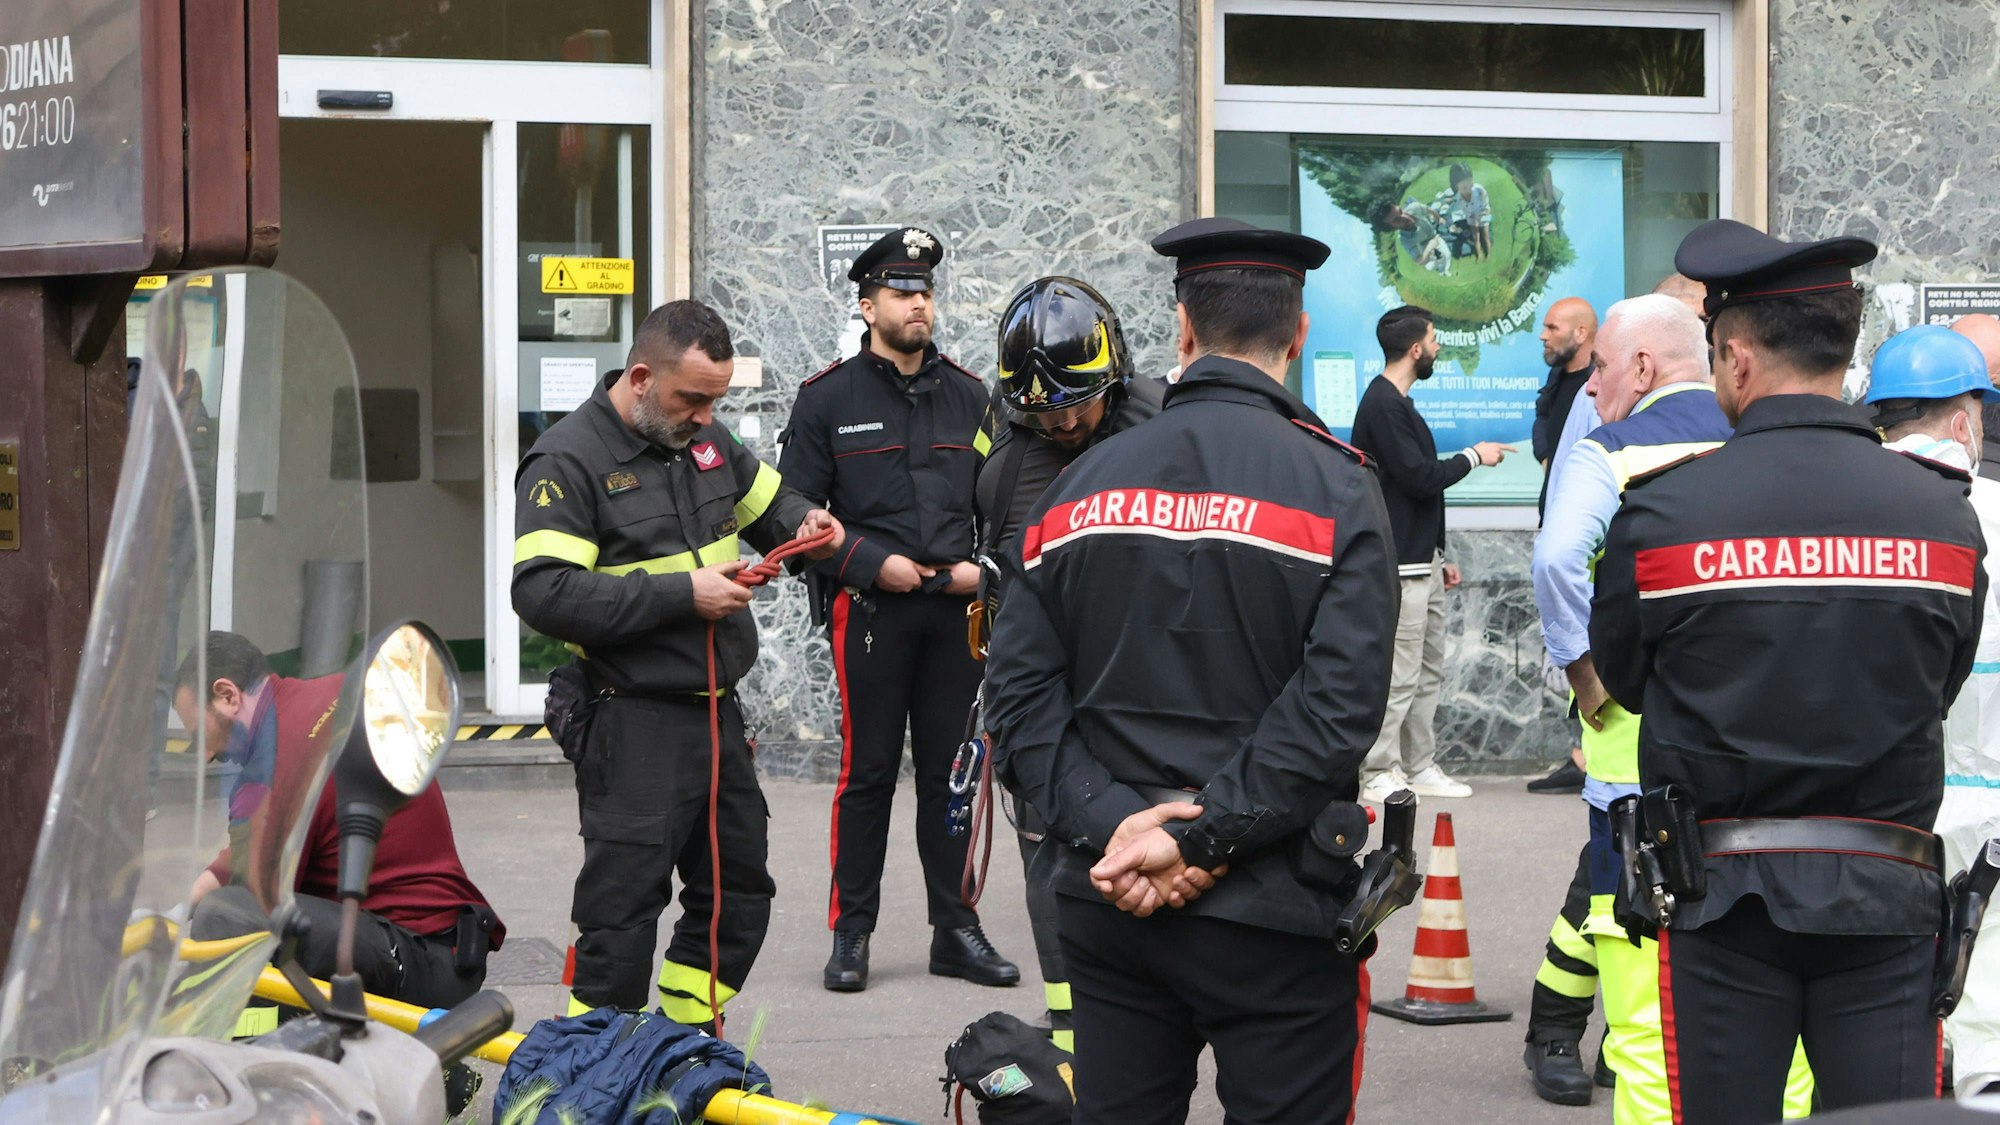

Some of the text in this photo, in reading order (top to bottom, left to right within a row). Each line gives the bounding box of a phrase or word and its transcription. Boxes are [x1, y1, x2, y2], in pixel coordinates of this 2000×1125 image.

[827, 233, 852, 242] RETE
[853, 233, 868, 241] NO
[580, 262, 631, 271] ATTENZIONE
[600, 272, 611, 280] AL
[586, 281, 625, 290] GRADINO
[1927, 290, 1949, 298] RETE
[1950, 290, 1962, 298] NO
[1963, 290, 1980, 298] DDL
[1928, 299, 1969, 308] CORTEO
[1477, 323, 1500, 344] vivi
[1498, 318, 1513, 336] la
[1507, 291, 1544, 327] Banca.
[1363, 360, 1381, 373] APP
[1442, 377, 1465, 389] TUTTI
[1471, 377, 1491, 390] TUOI
[838, 421, 884, 435] CARABINIERI
[548, 480, 565, 500] FUOCO
[1068, 490, 1259, 532] CARABINIERI
[1693, 537, 1928, 580] CARABINIERI
